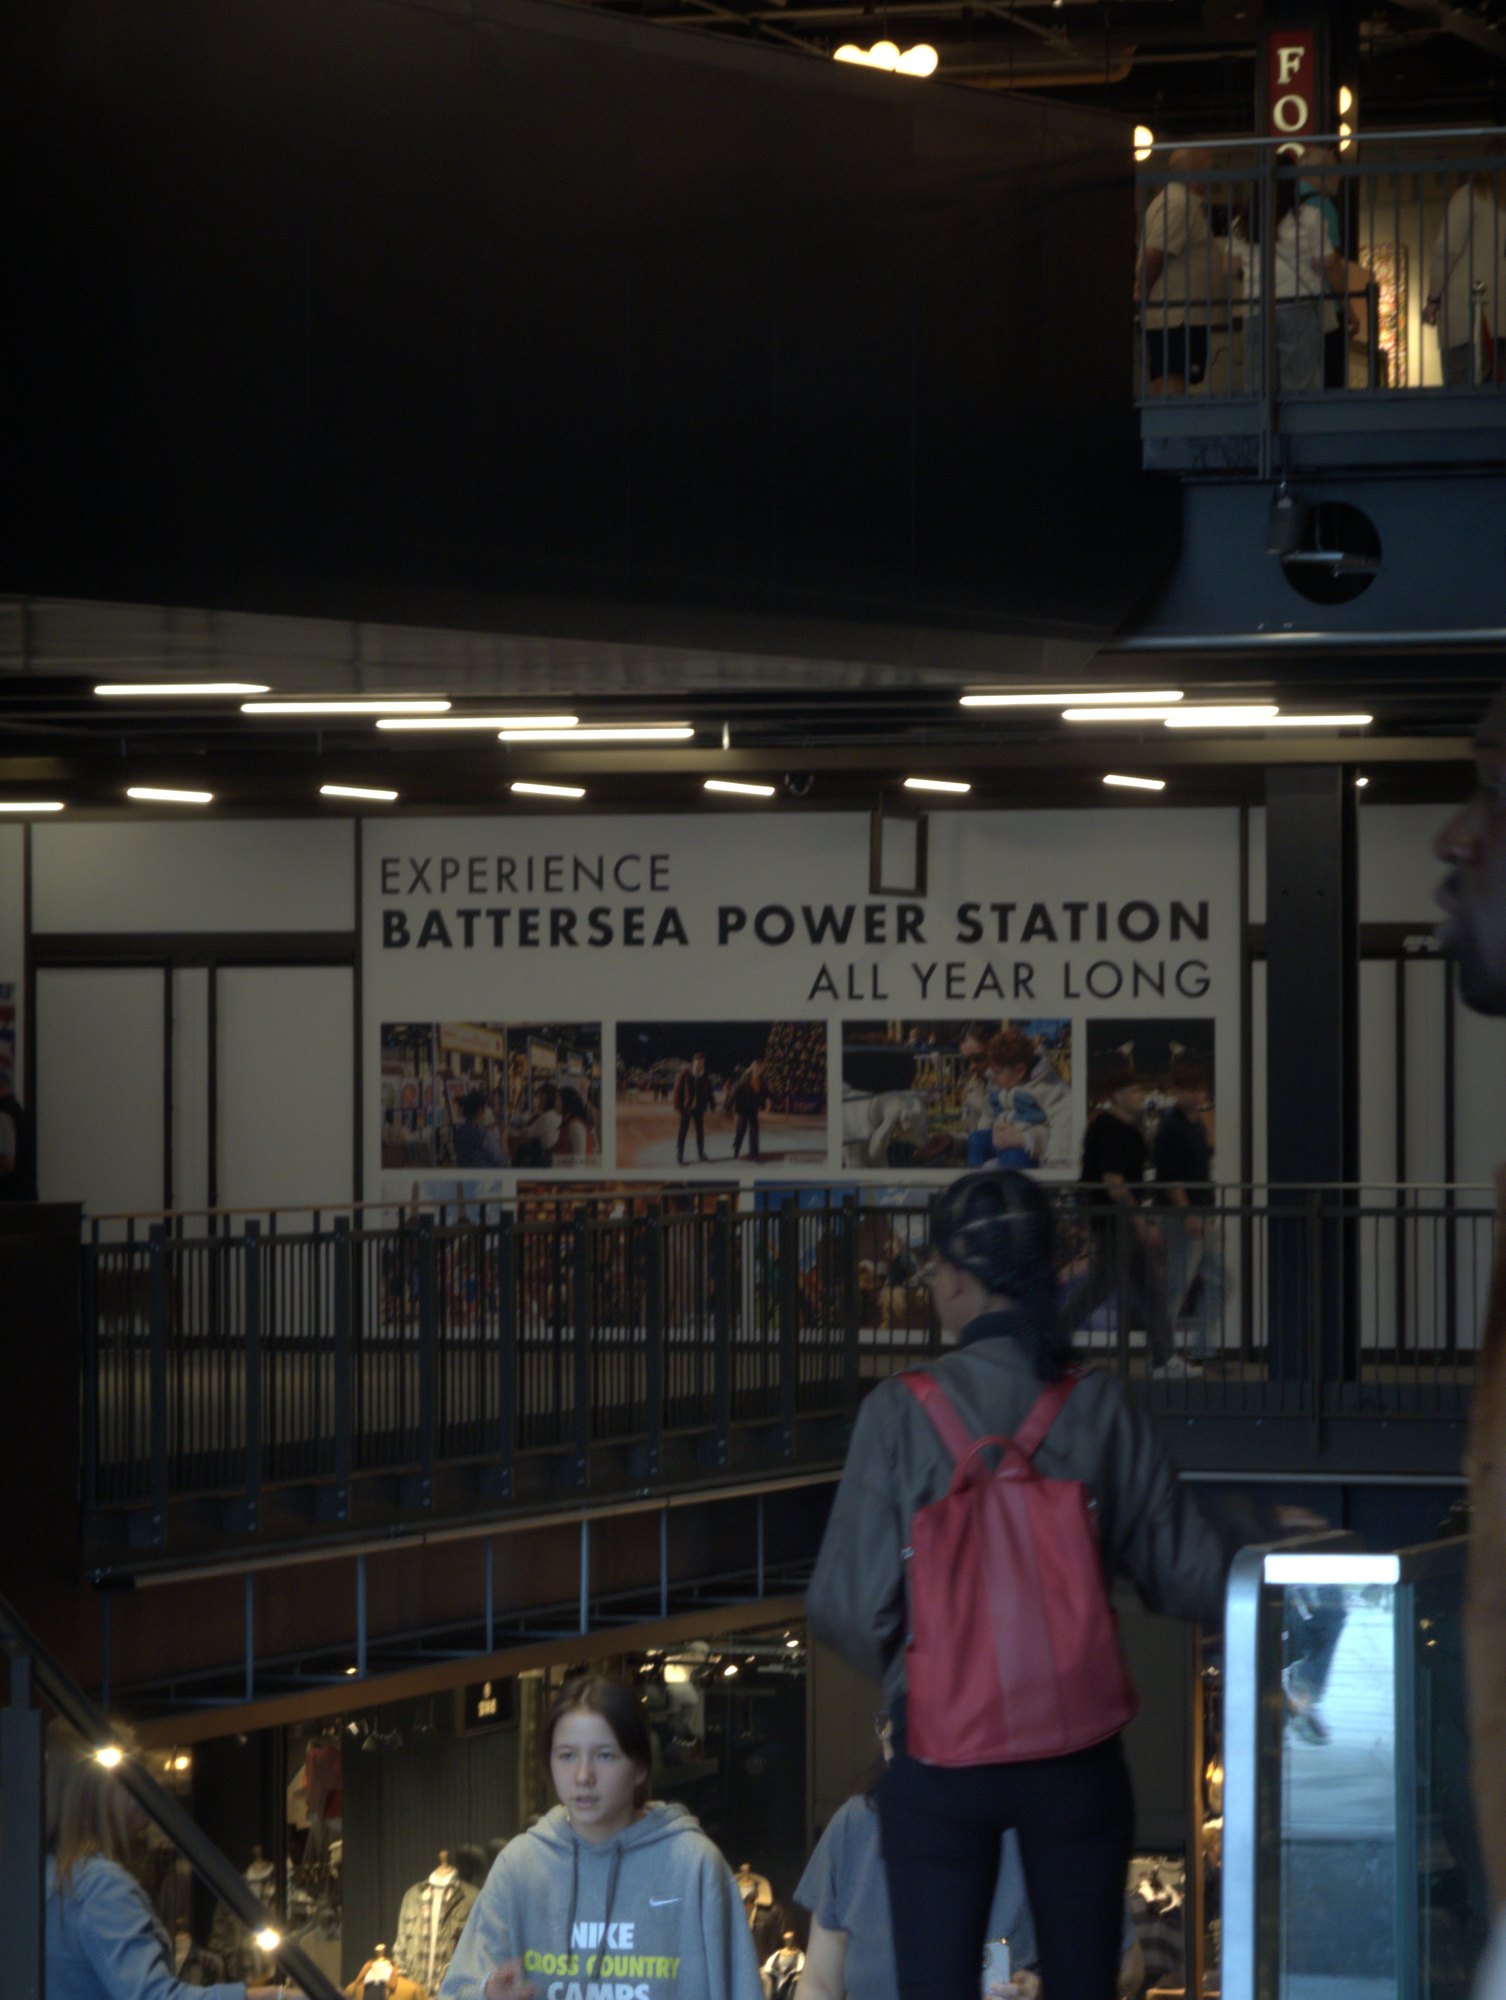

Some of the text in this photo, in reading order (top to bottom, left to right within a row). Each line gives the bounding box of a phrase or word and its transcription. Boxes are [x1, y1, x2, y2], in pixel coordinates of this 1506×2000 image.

[381, 854, 671, 895] EXPERIENCE
[382, 899, 1211, 949] BATTERSEA POWER STATION
[807, 958, 1212, 1001] ALL YEAR LONG
[570, 1921, 635, 1950] NIKE
